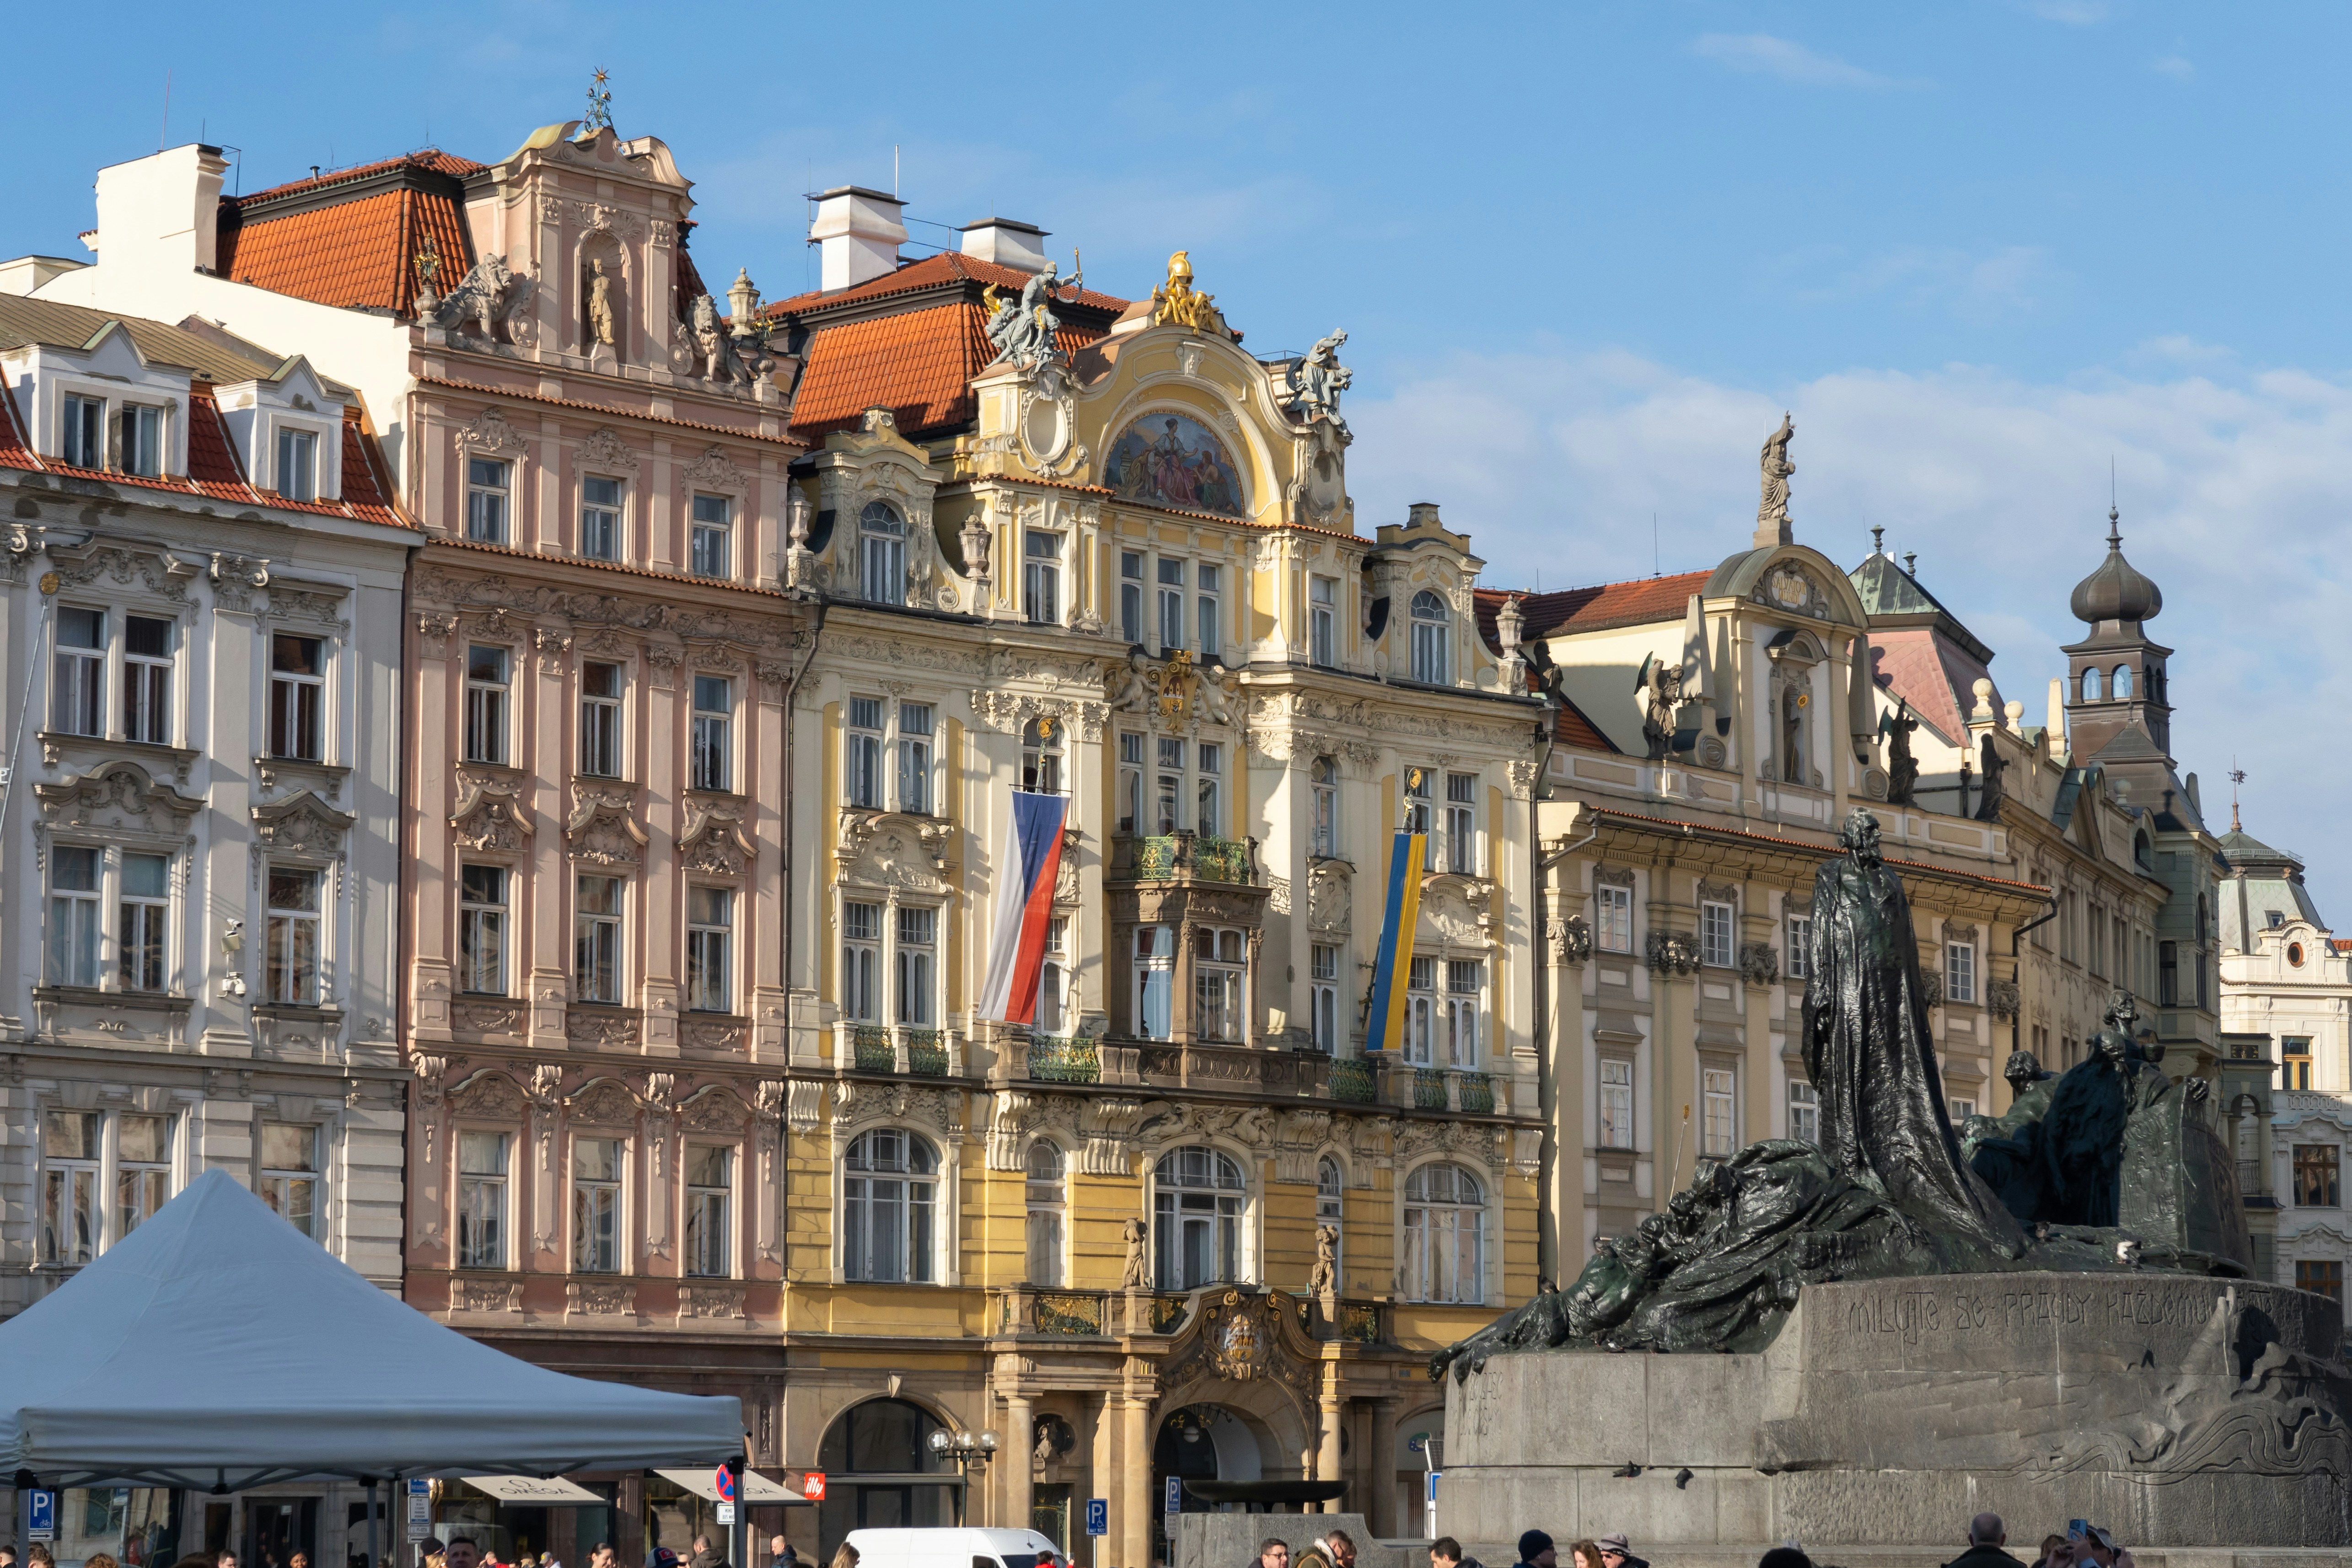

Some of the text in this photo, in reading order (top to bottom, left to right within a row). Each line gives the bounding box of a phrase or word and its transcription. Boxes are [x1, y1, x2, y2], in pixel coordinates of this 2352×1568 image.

[1772, 575, 1806, 595] SALVATOR
[1779, 590, 1799, 604] MUNDI
[805, 1477, 823, 1497] illy
[1170, 1482, 1178, 1501] P
[34, 1493, 48, 1517] P
[1092, 1504, 1103, 1524] P
